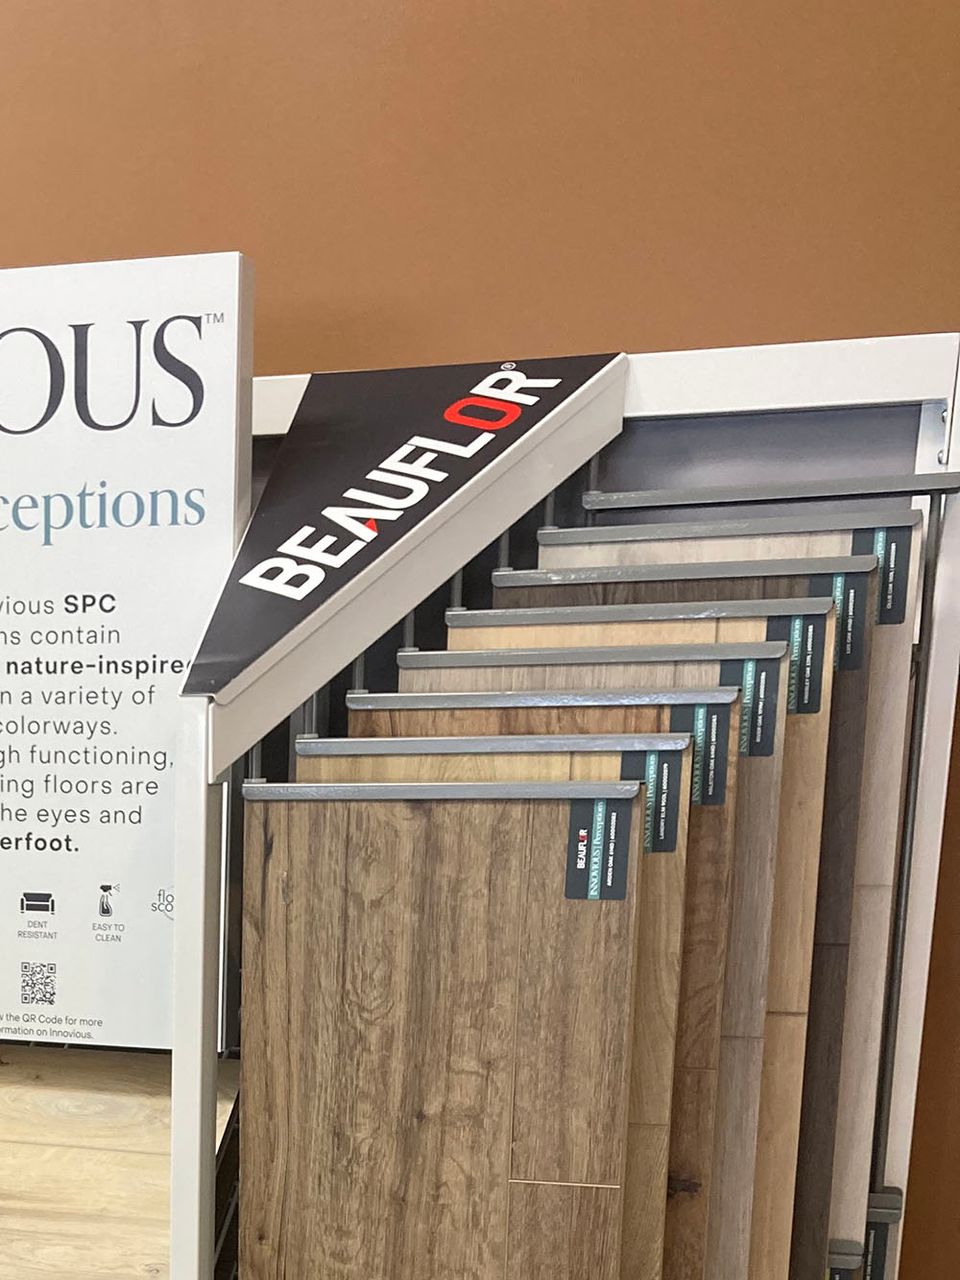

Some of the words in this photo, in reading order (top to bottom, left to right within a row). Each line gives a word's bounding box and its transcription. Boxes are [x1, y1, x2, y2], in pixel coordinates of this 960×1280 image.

[63, 594, 116, 613] SPC
[30, 625, 120, 645] contain
[5, 654, 192, 679] nature-inspire
[20, 690, 33, 704] a
[41, 685, 123, 710] variety
[131, 684, 156, 704] of
[30, 744, 174, 771] functioning,
[44, 774, 112, 795] floors
[121, 780, 159, 795] are
[37, 807, 91, 827] eyes
[99, 805, 142, 824] and
[577, 829, 588, 869] BEAUFLOR
[27, 920, 48, 929] DENT
[92, 922, 112, 932] EASY
[113, 923, 125, 932] TO
[17, 930, 58, 940] RESISTANT
[95, 933, 122, 942] CLEAN
[5, 1011, 21, 1023] the
[22, 1012, 37, 1023] QR
[38, 1013, 63, 1025] Code
[64, 1014, 77, 1026] for
[78, 1017, 103, 1027] more
[36, 1026, 48, 1036] on
[49, 1026, 94, 1039] Innovious.
